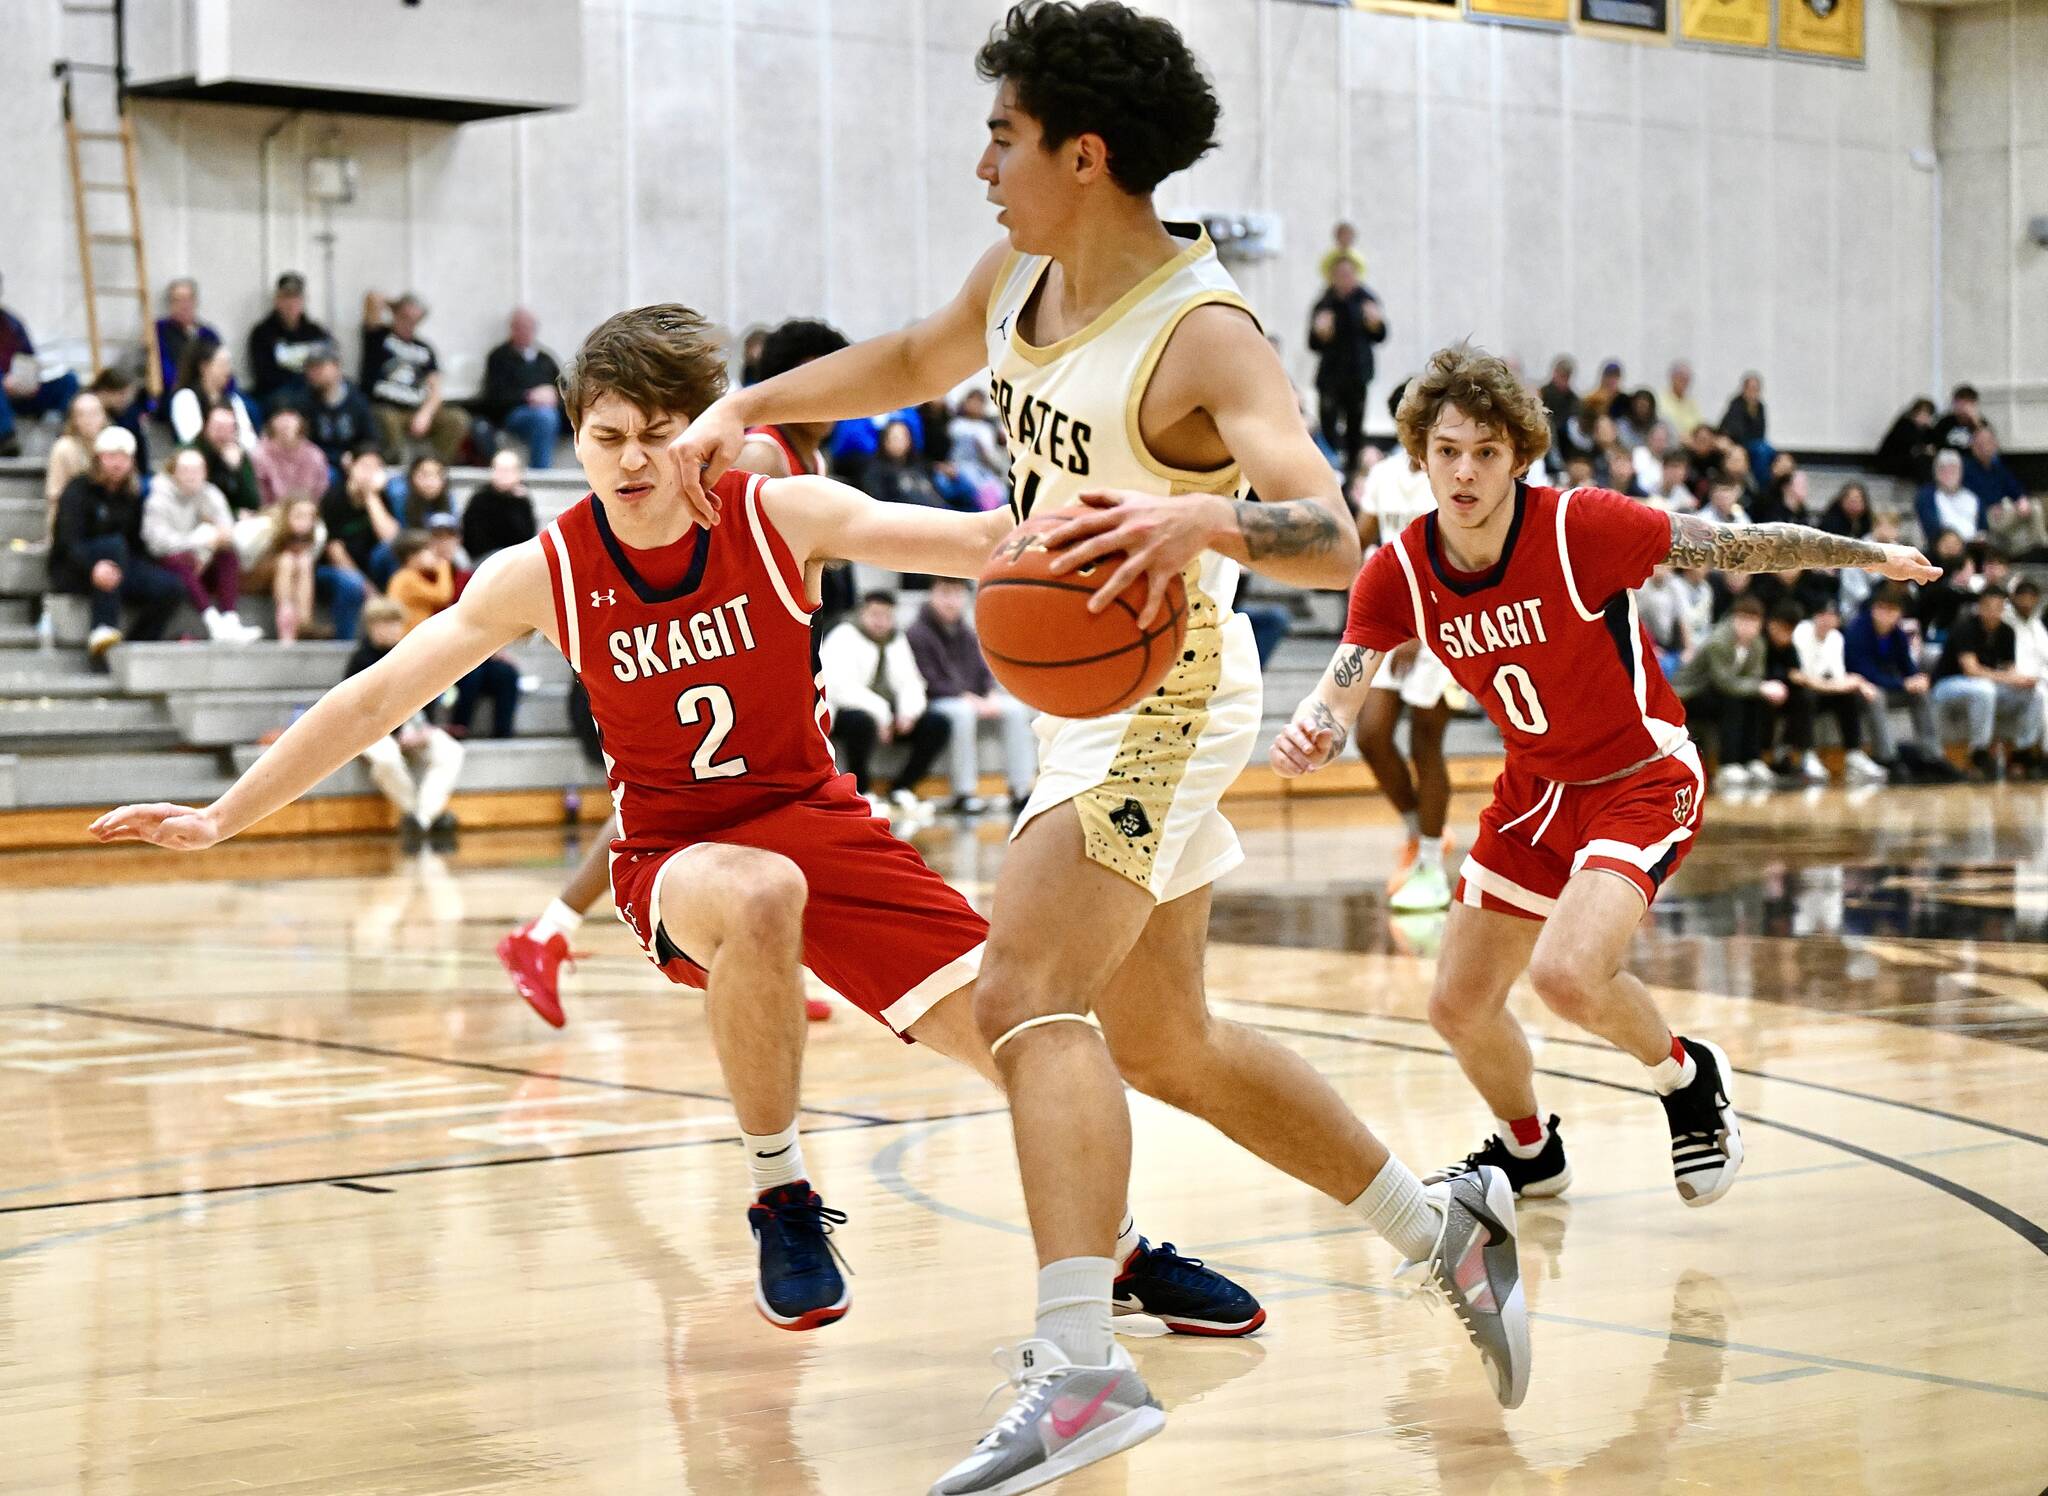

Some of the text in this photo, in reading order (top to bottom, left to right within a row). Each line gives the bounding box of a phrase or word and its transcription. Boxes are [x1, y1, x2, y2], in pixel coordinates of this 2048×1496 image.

[608, 593, 756, 683] SKAGIT
[1439, 597, 1548, 660] SKAGIT
[675, 683, 748, 781] 2
[1492, 663, 1549, 735] 0
